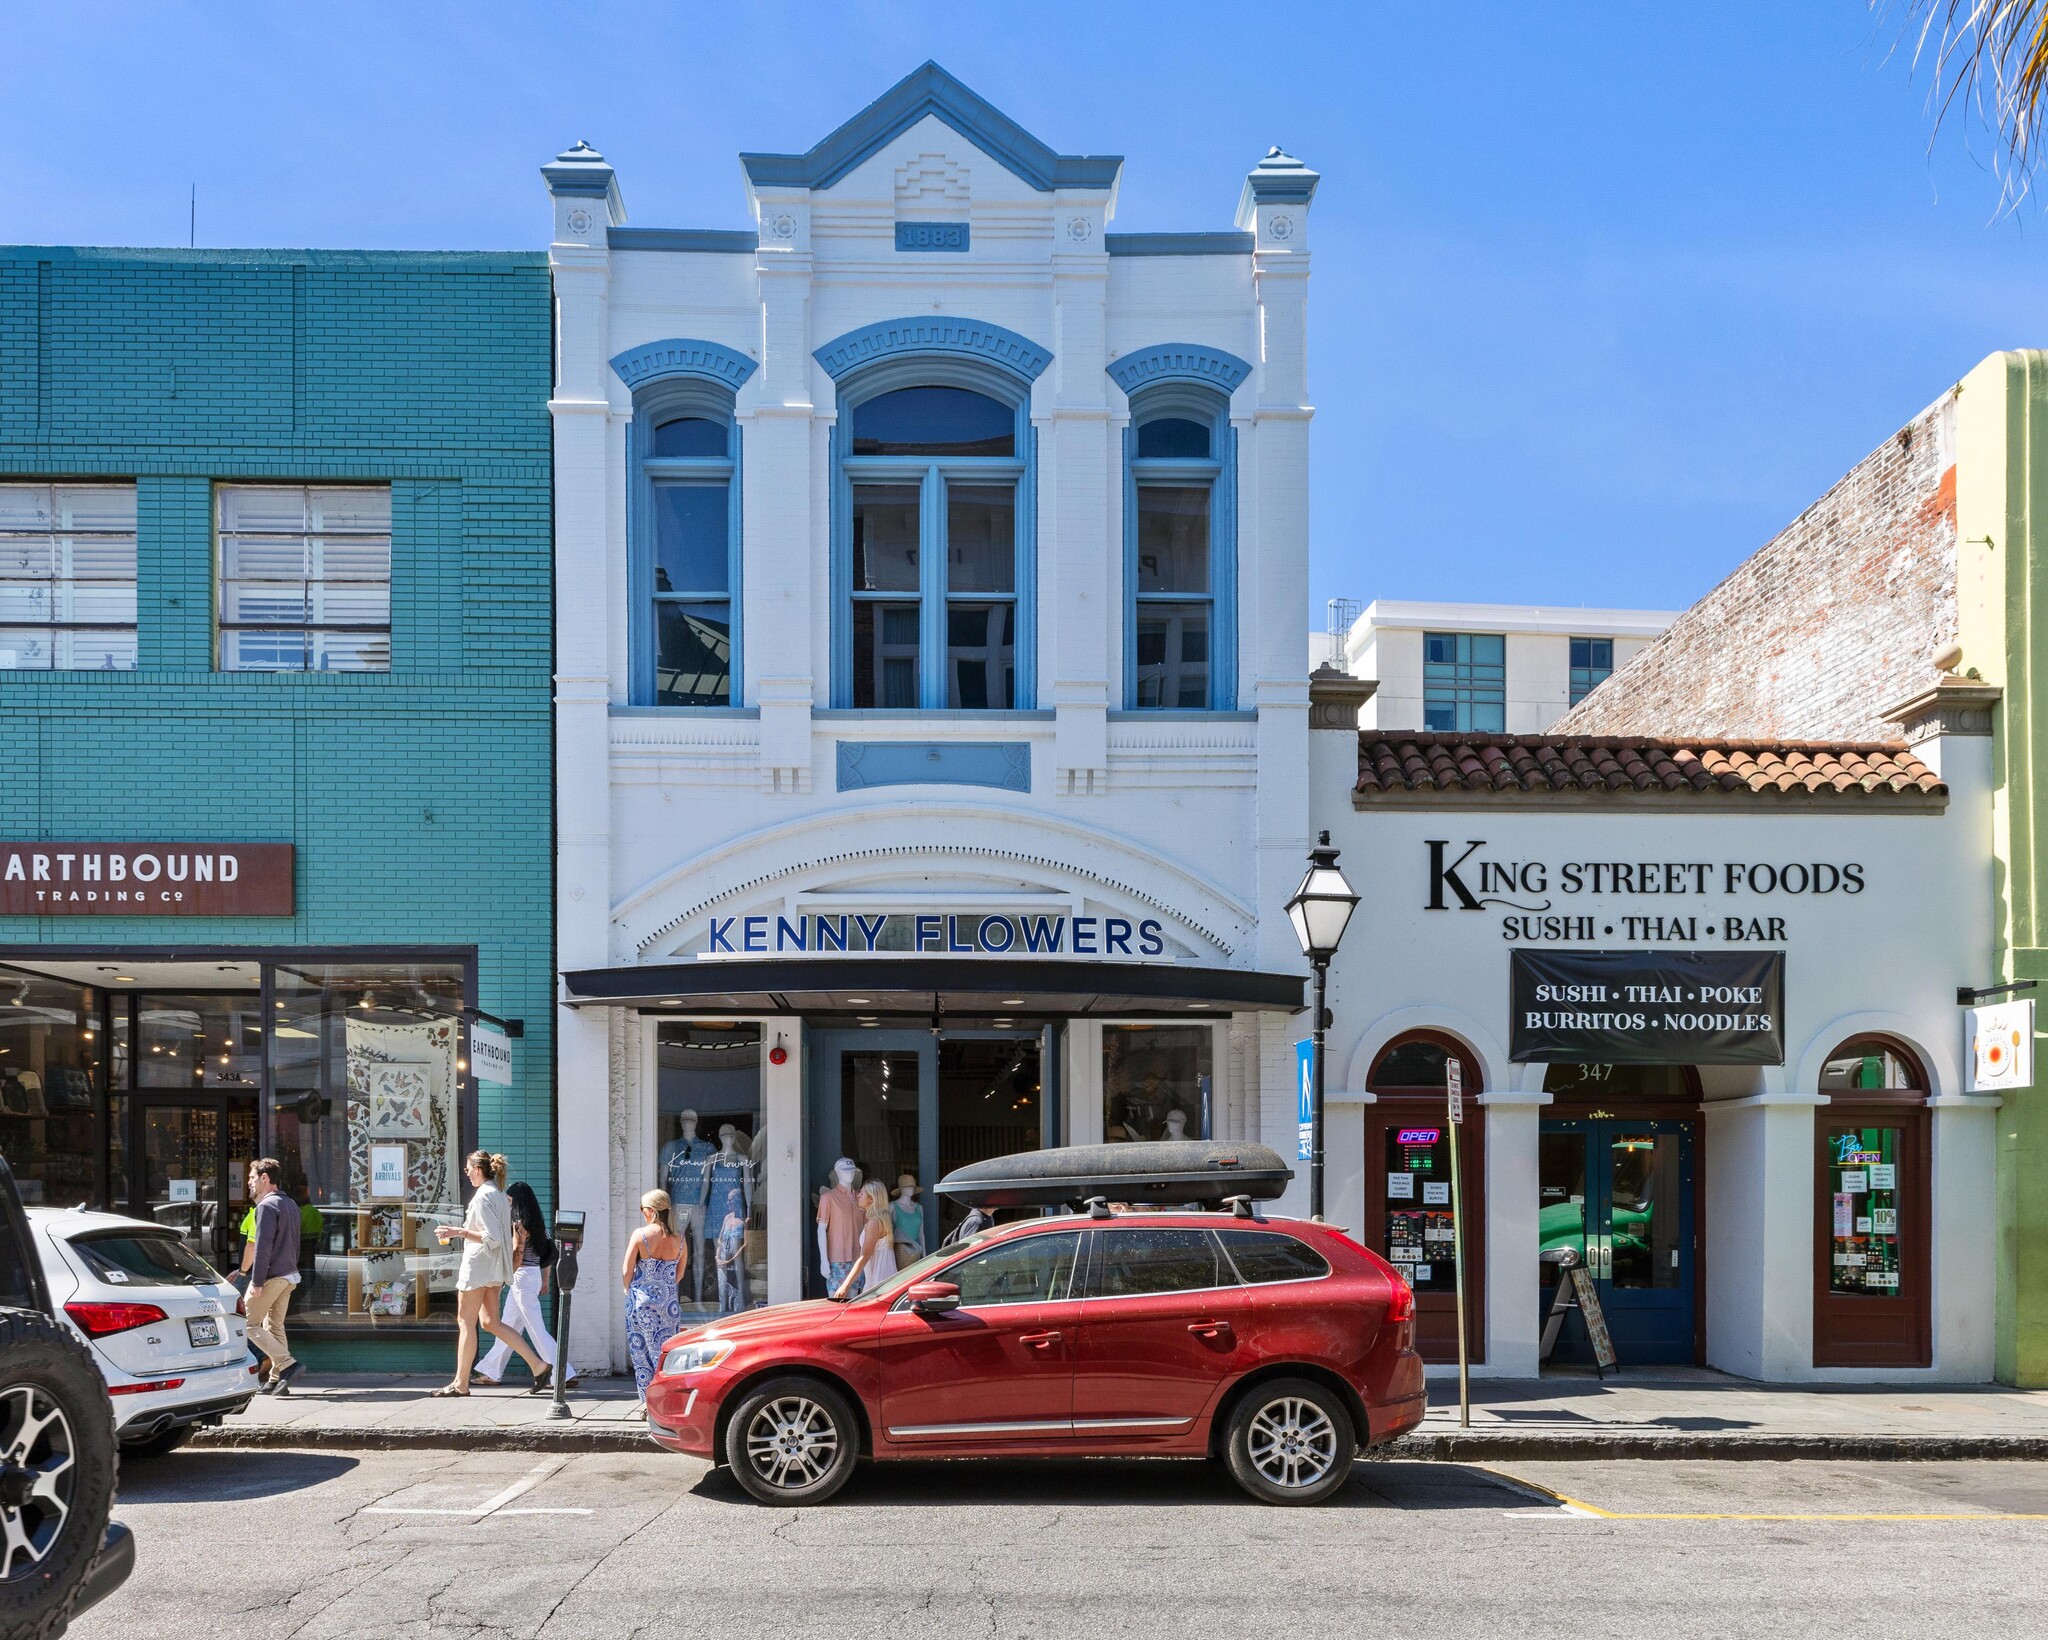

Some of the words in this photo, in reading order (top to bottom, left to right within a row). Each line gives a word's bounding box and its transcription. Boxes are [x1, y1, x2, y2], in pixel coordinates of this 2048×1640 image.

[902, 226, 961, 248] 1883
[4, 854, 238, 881] ARTHBOUND
[1424, 839, 1550, 910] KING
[1561, 862, 1713, 894] STREET
[1724, 862, 1865, 894] FOODS
[36, 891, 145, 901] TRADING
[708, 914, 889, 953] KENNY
[914, 914, 1165, 955] FLOWERS
[1502, 916, 1596, 941] SUSHI
[1622, 916, 1698, 941] THAI
[1725, 917, 1788, 941] BAR
[1535, 984, 1608, 1003] SUSHI
[1624, 986, 1683, 1003] THAI
[1699, 986, 1762, 1004] POKE
[1525, 1012, 1646, 1030] BURRITOS
[1663, 1013, 1772, 1031] NOODLES
[473, 1039, 511, 1063] EARTHBOUND
[1578, 1064, 1613, 1081] 347
[1399, 1131, 1437, 1141] OPEN
[1836, 1135, 1862, 1161] Bar
[1847, 1153, 1881, 1162] OPEN
[381, 1162, 395, 1171] NEW
[668, 1150, 710, 1174] Kenny
[710, 1152, 757, 1171] Flowers
[374, 1172, 402, 1182] ARRIVALS
[177, 1187, 189, 1195] OPEN
[1875, 1210, 1895, 1224] 10%
